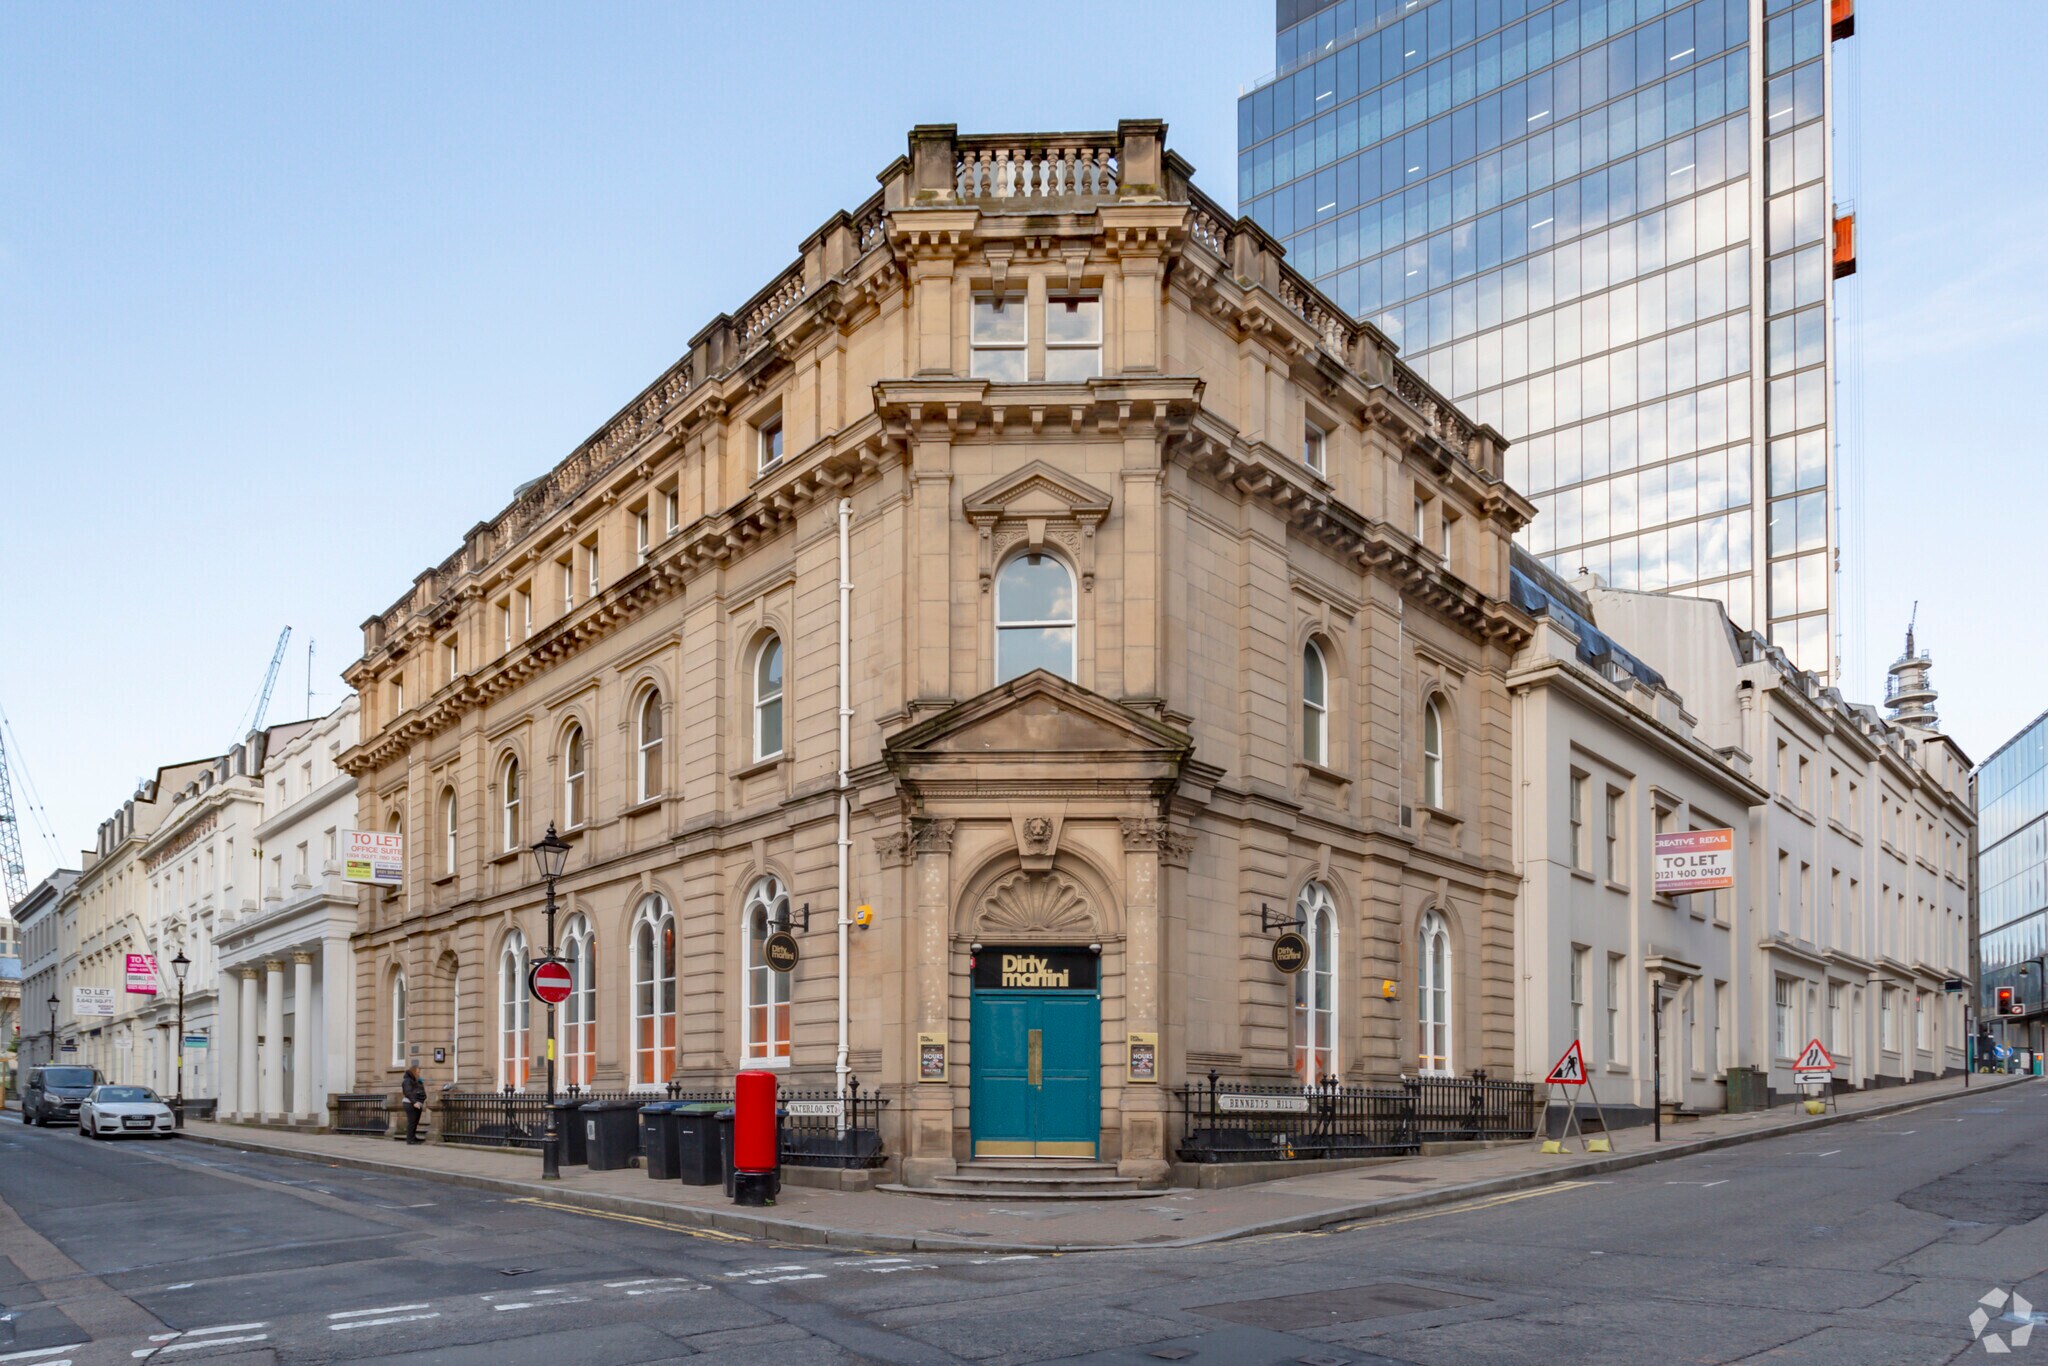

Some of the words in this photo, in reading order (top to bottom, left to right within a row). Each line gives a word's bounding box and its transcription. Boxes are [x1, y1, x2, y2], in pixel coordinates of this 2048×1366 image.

[352, 833, 371, 845] TO
[376, 835, 402, 847] LET
[1656, 838, 1695, 848] CREATIVE
[1699, 836, 1728, 844] RETAIL
[351, 845, 378, 853] OFFICE
[1663, 857, 1686, 868] TO
[1690, 854, 1718, 867] LET
[1656, 871, 1674, 879] 0121
[1677, 869, 1697, 878] 400
[1701, 867, 1727, 877] 0407
[771, 945, 788, 955] Dirty
[1277, 947, 1293, 955] Dirty
[130, 956, 142, 964] TO
[771, 952, 794, 961] martini
[1277, 952, 1301, 961] martini
[1002, 954, 1048, 974] Dirty
[1002, 969, 1069, 987] martini
[790, 1104, 824, 1113] WATERLOO
[826, 1104, 835, 1113] ST
[1229, 1099, 1269, 1108] BENNETTS
[1276, 1100, 1293, 1109] HILL
